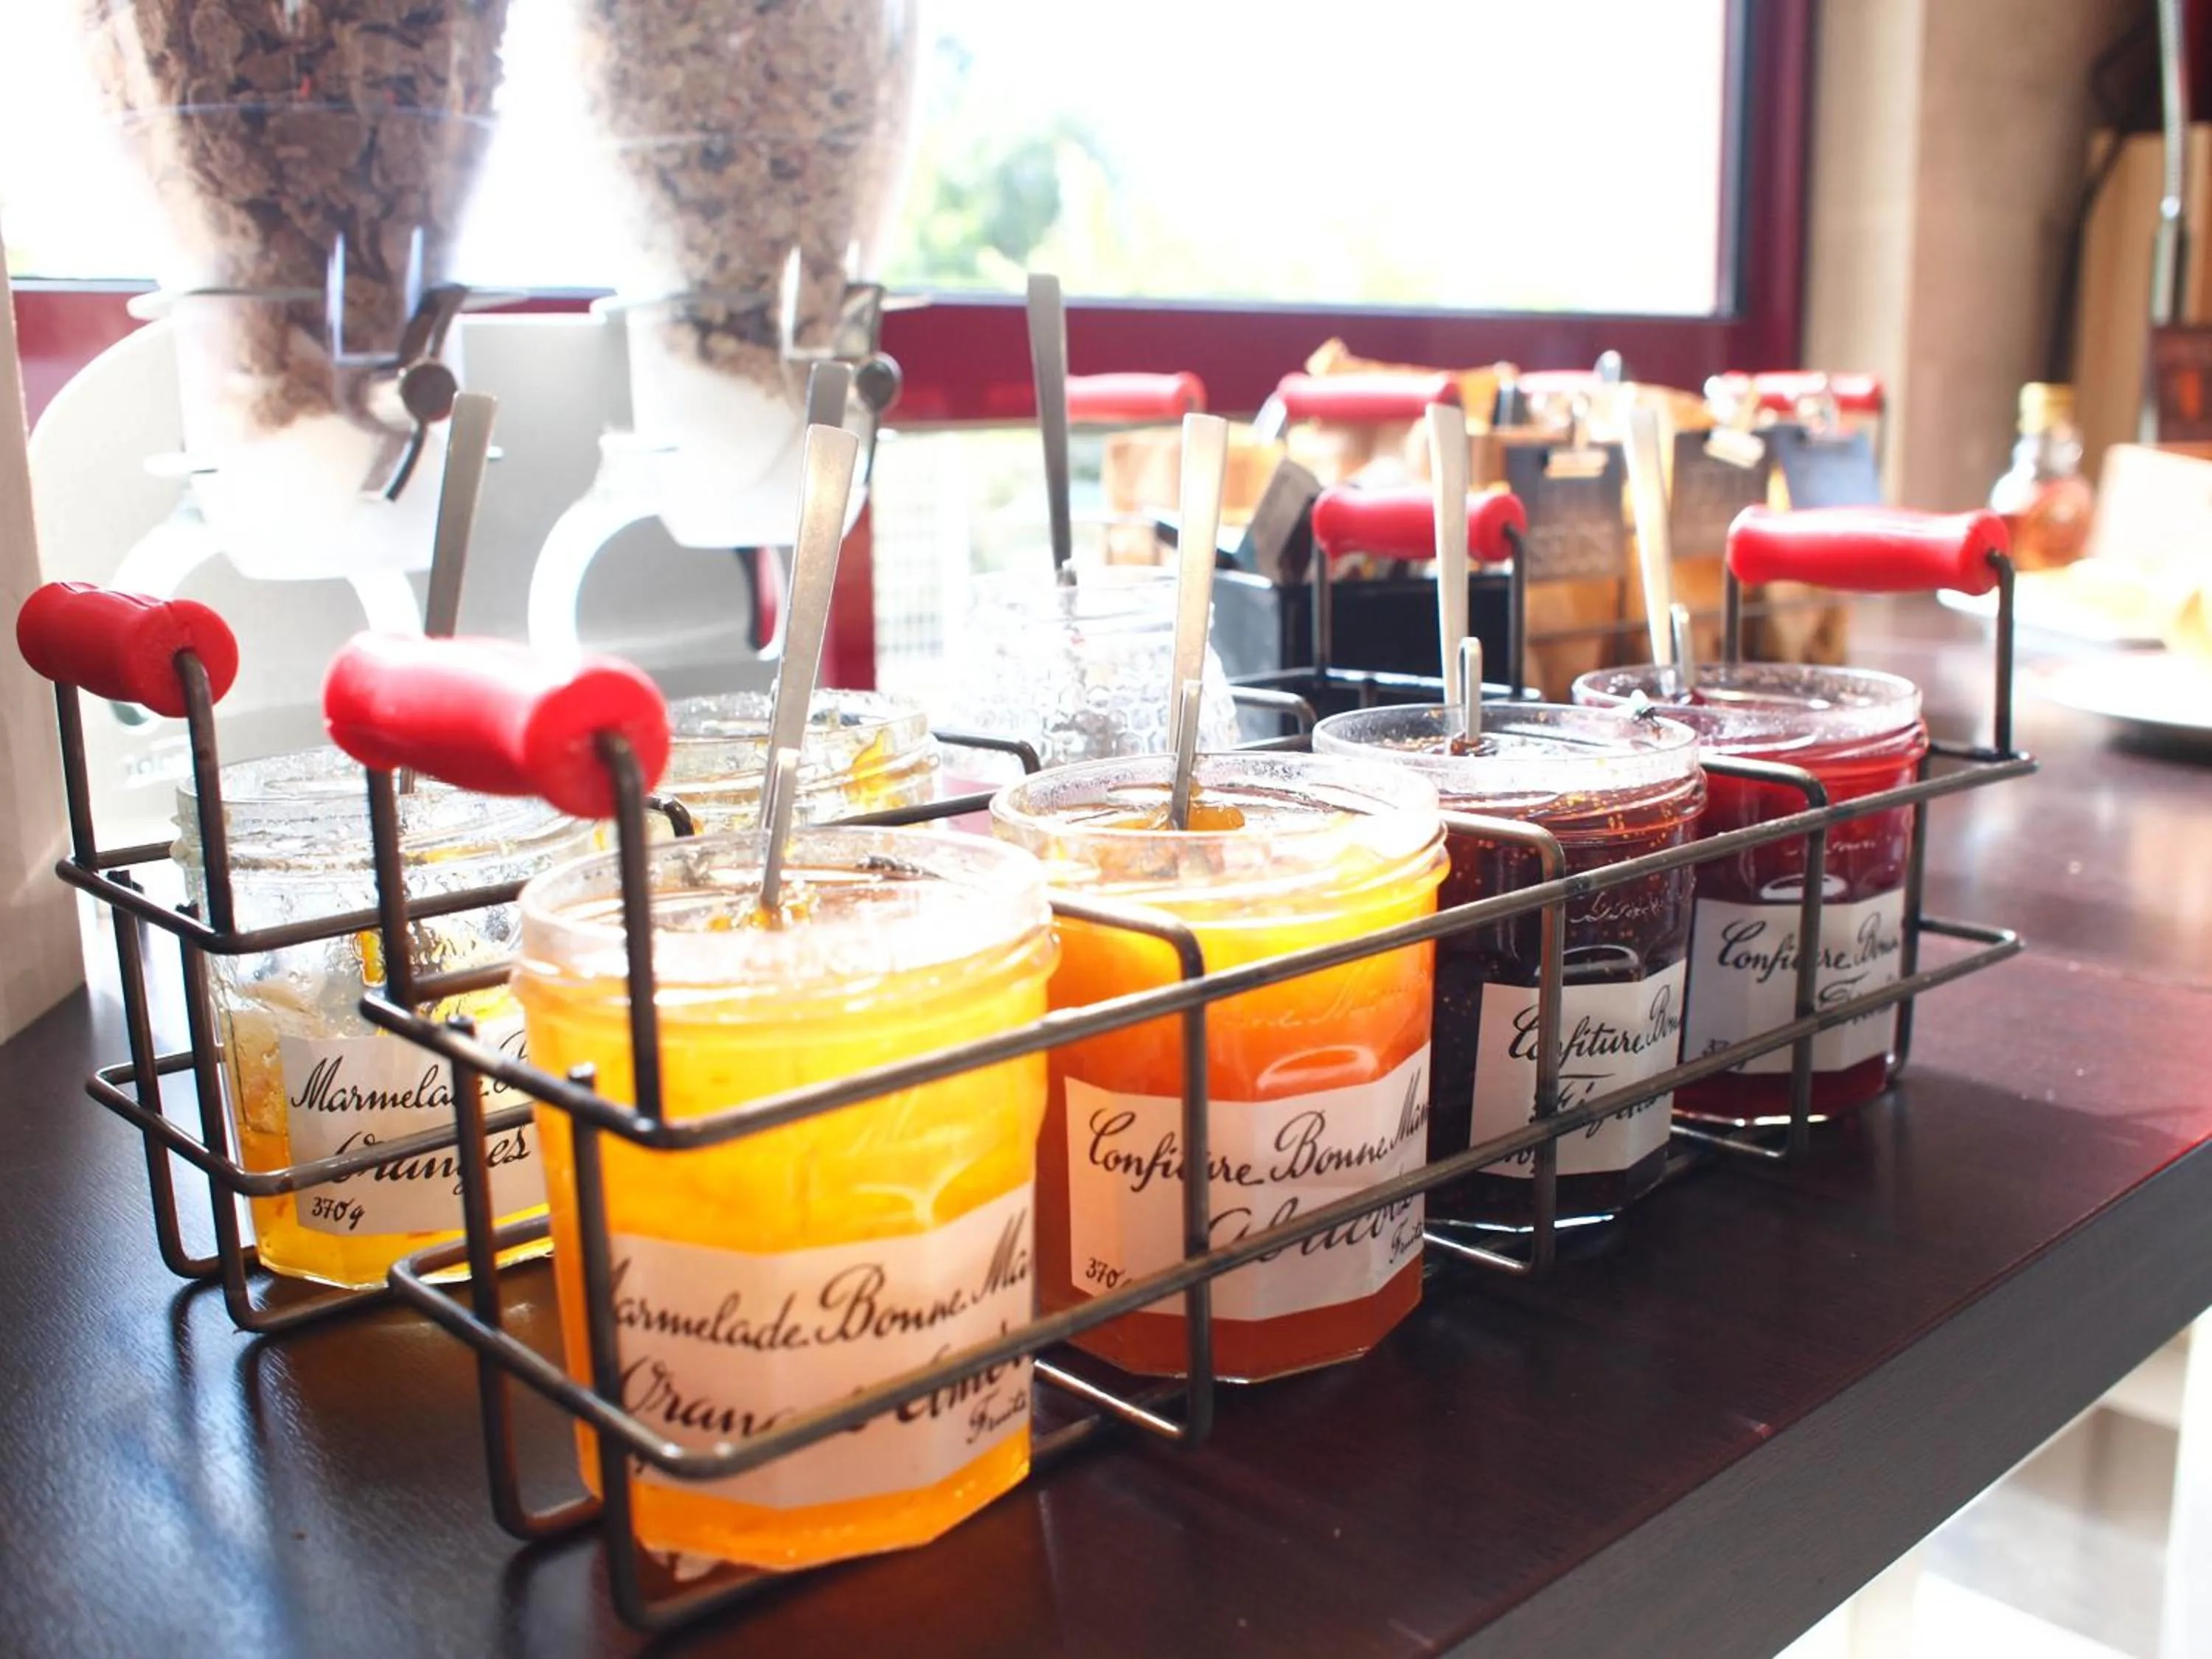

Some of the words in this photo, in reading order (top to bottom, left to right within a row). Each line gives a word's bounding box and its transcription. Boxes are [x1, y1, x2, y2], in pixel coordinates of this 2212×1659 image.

[1717, 920, 1851, 984] Confire
[1509, 1004, 1644, 1068] Cofiture
[291, 1055, 490, 1113] Marmela
[1089, 1108, 1265, 1192] Confire
[1270, 1110, 1387, 1181] Bonne
[815, 1262, 967, 1345] Bonne
[1085, 1256, 1133, 1289] 370
